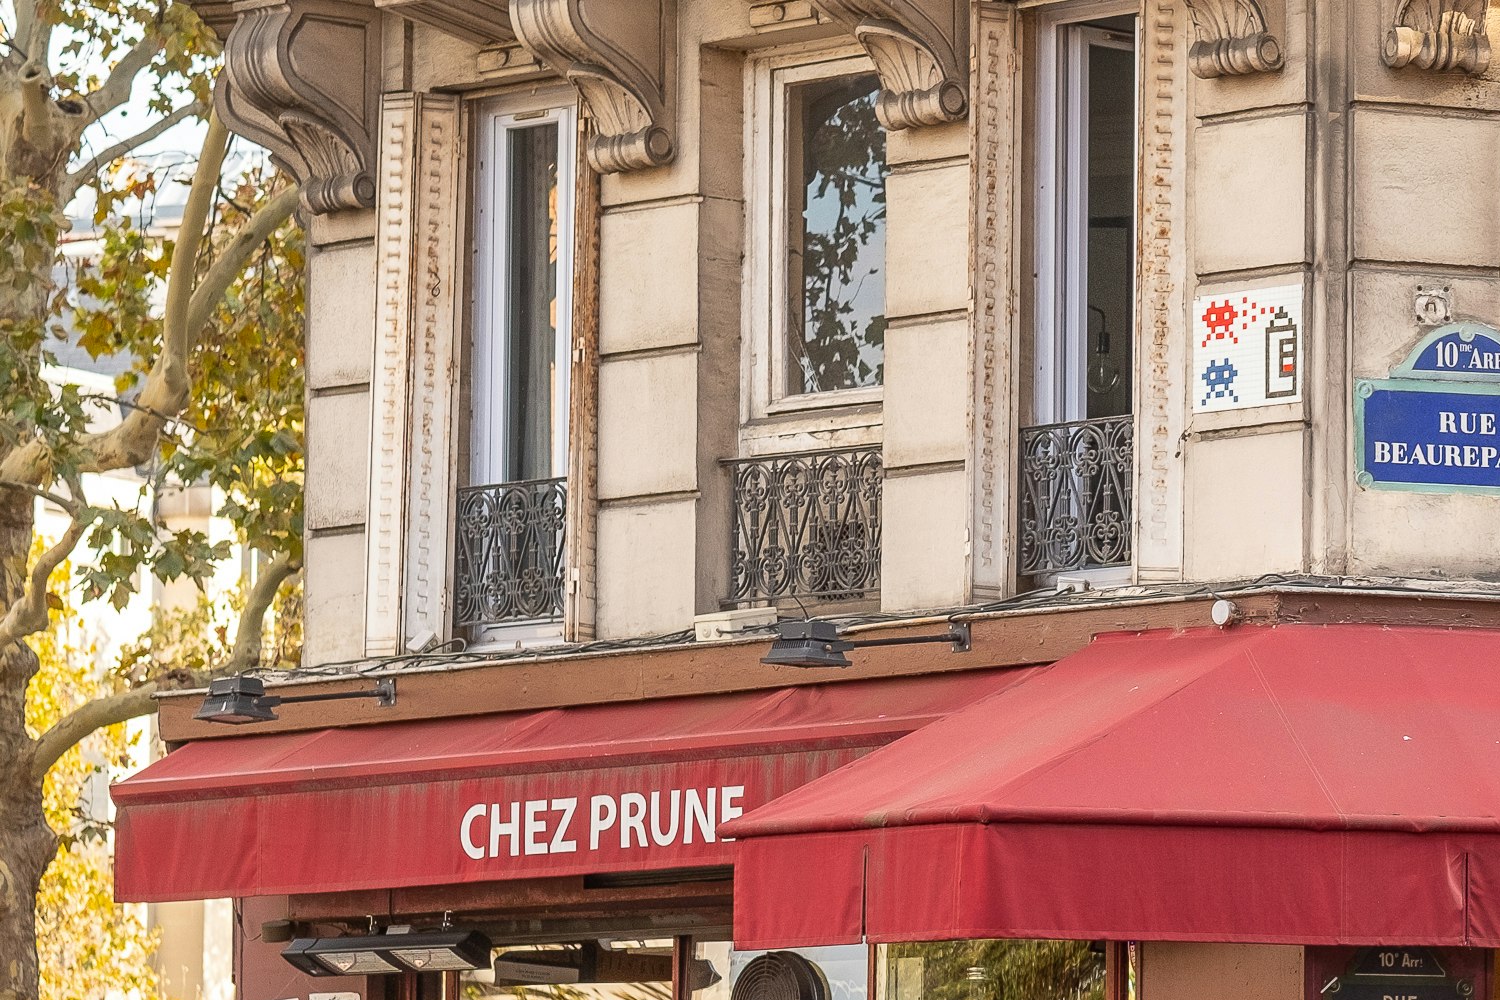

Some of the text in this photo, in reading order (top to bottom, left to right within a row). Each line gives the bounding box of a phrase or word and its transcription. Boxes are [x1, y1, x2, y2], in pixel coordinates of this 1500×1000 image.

[1438, 411, 1496, 435] RUE
[459, 785, 745, 860] CHEZ PRUNE
